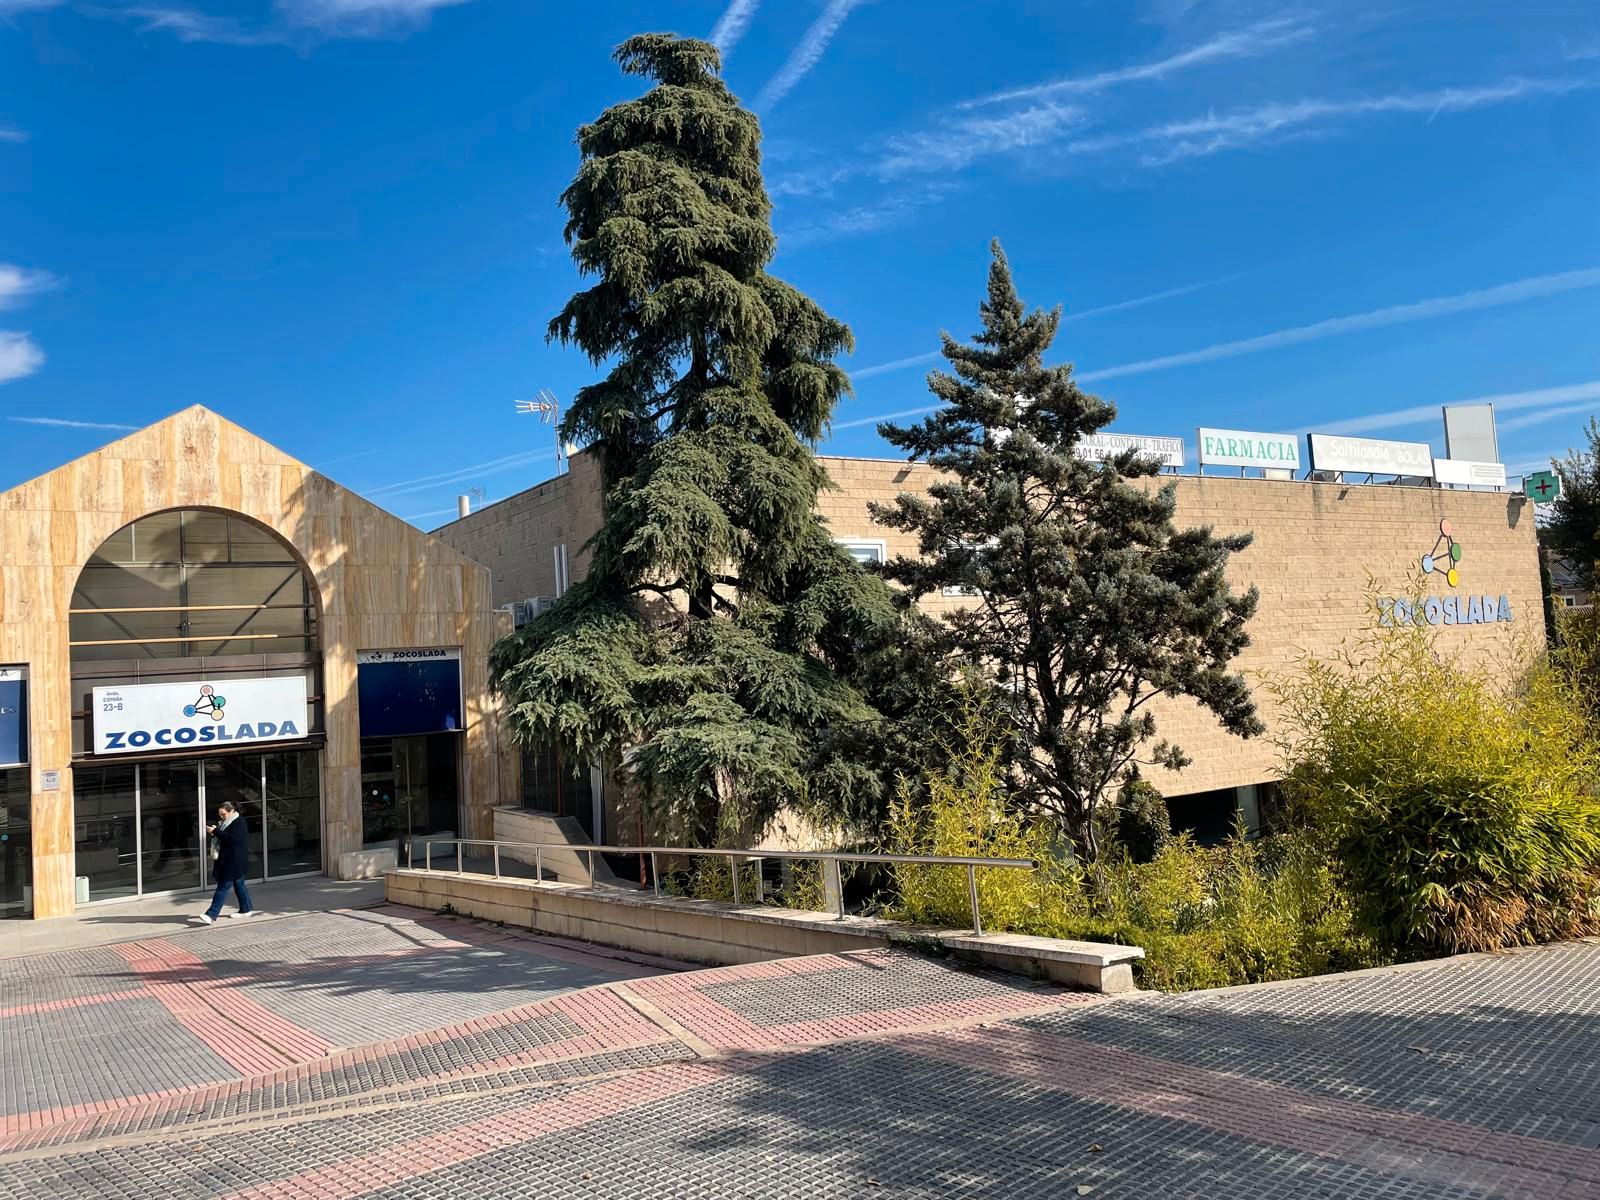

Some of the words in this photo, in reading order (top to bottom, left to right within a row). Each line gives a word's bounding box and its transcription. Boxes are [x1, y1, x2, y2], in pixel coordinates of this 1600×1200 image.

[1204, 435, 1297, 461] FARMACIA
[1376, 592, 1513, 627] ZOCOSLADA
[392, 649, 447, 659] ZOCOSLADA
[103, 702, 124, 711] 23-B
[104, 720, 299, 749] ZOCOSLADA
